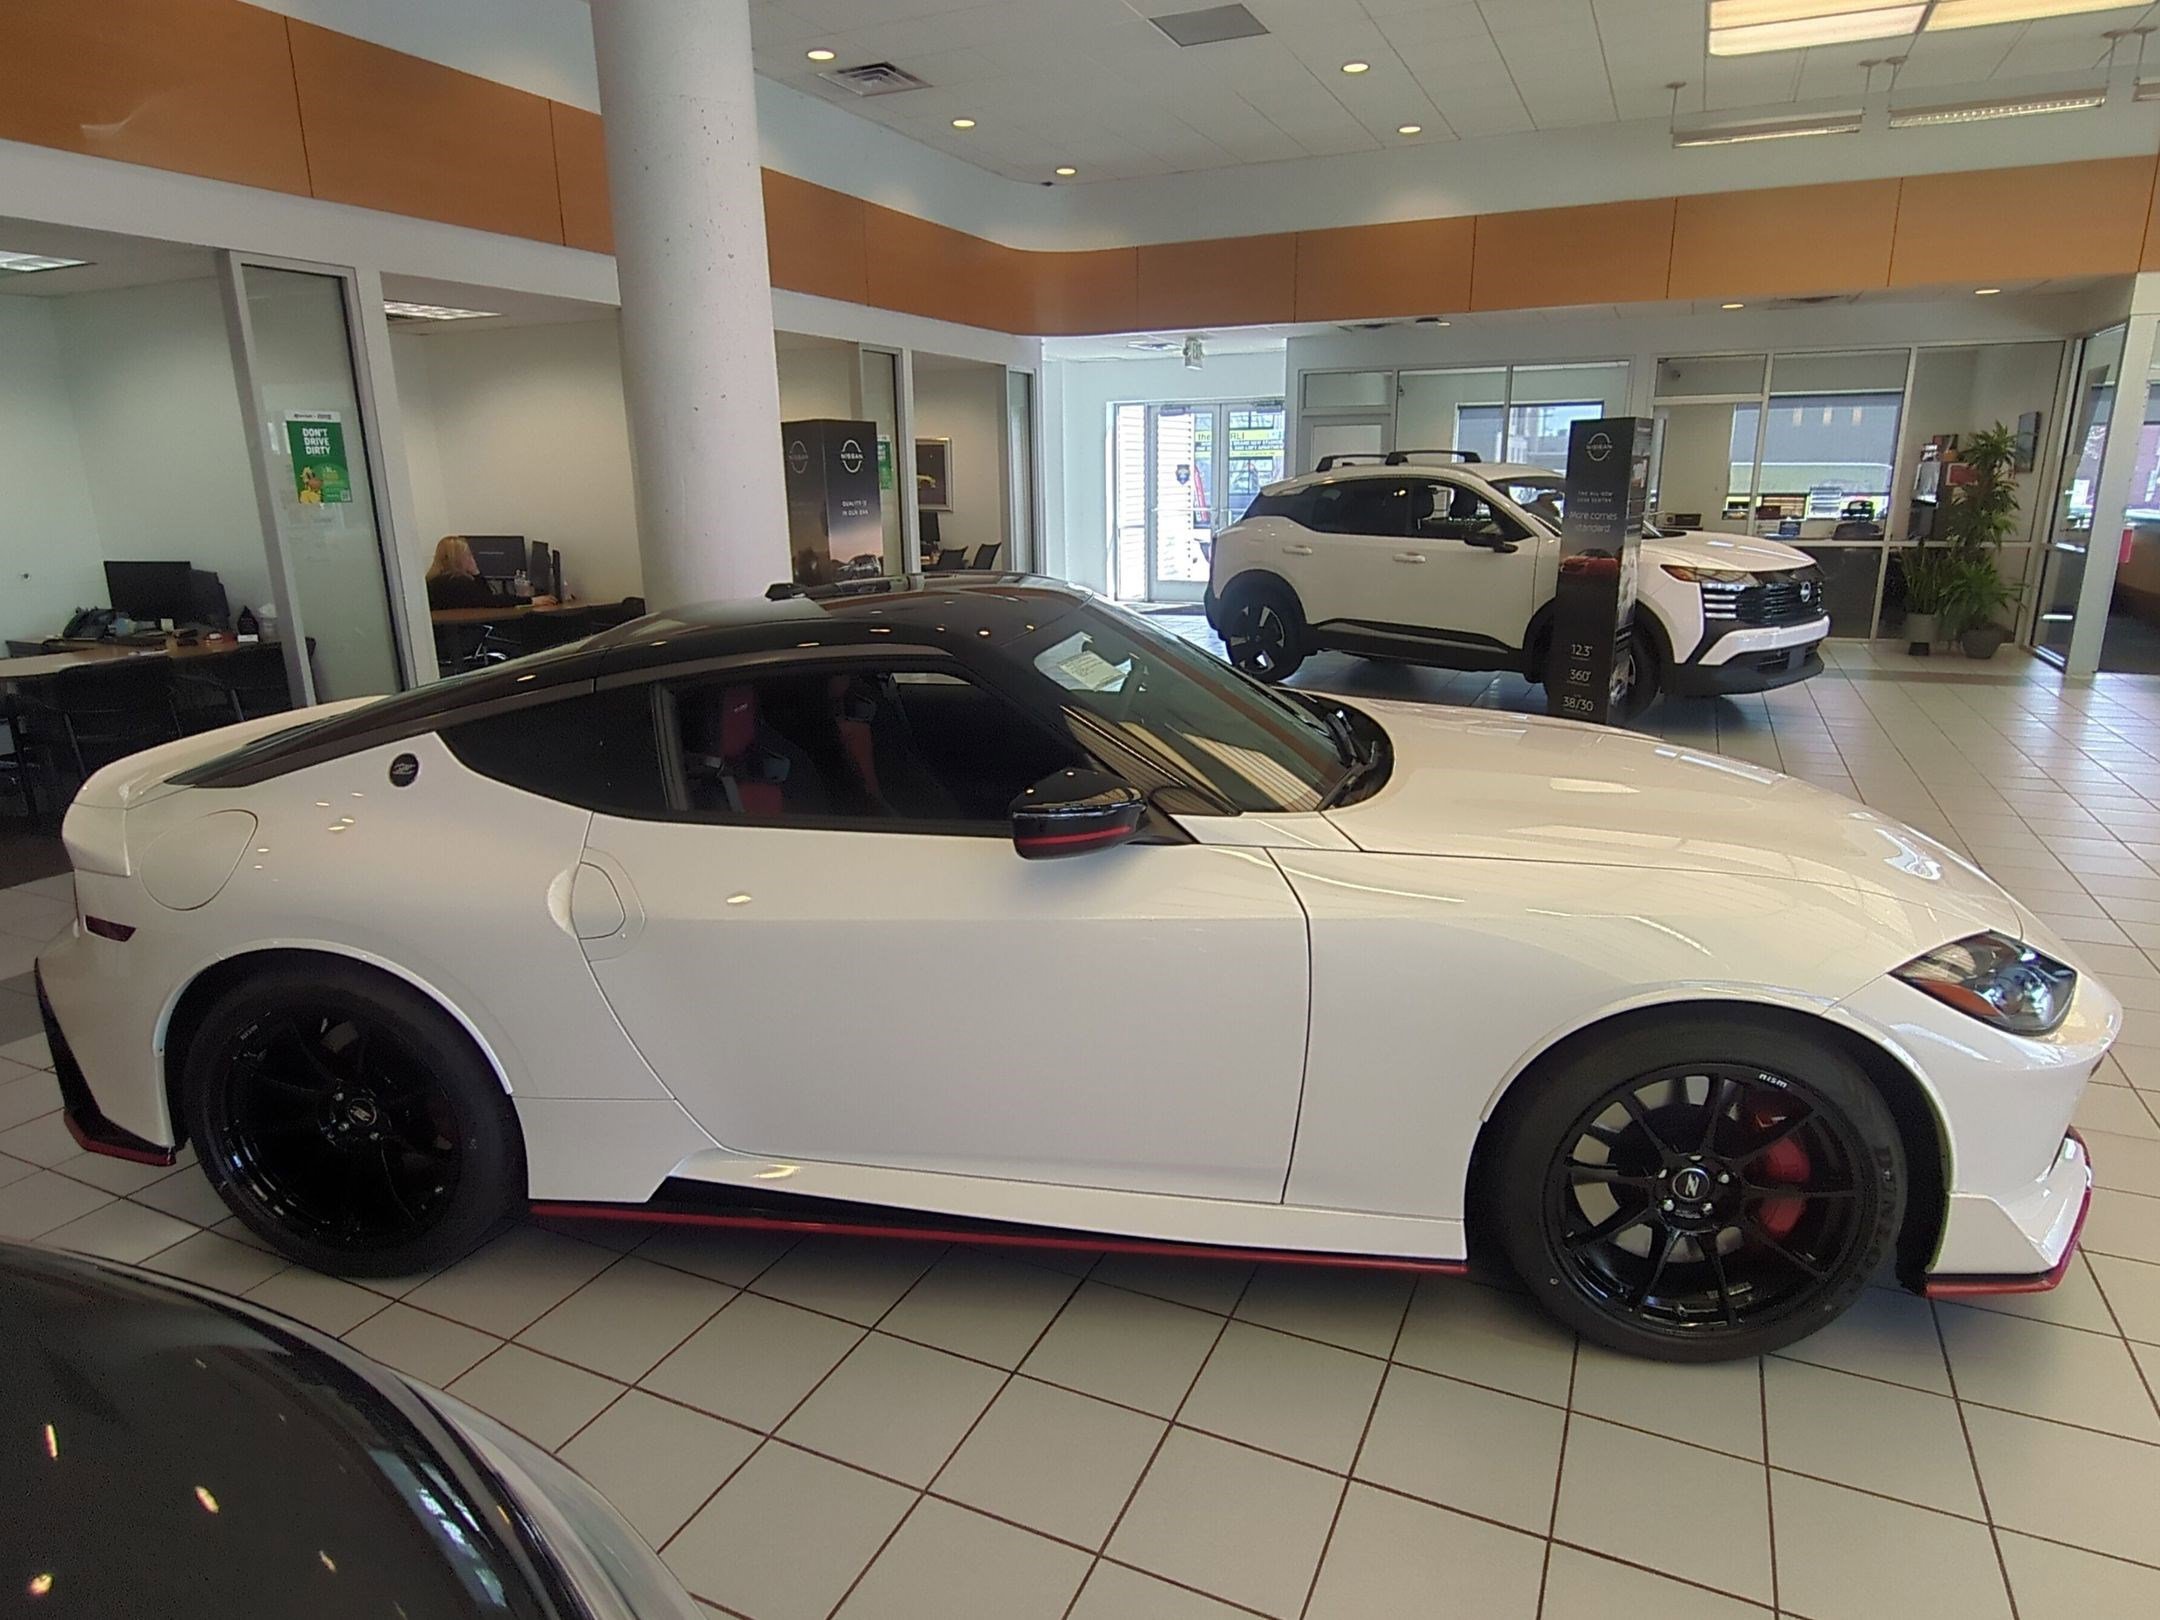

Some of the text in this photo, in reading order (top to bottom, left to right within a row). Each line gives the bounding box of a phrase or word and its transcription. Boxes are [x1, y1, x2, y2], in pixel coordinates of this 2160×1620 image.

[302, 427, 328, 437] DON'T
[303, 437, 330, 446] DRIVE
[305, 446, 331, 455] DIRTY
[1562, 696, 1594, 712] 38/30
